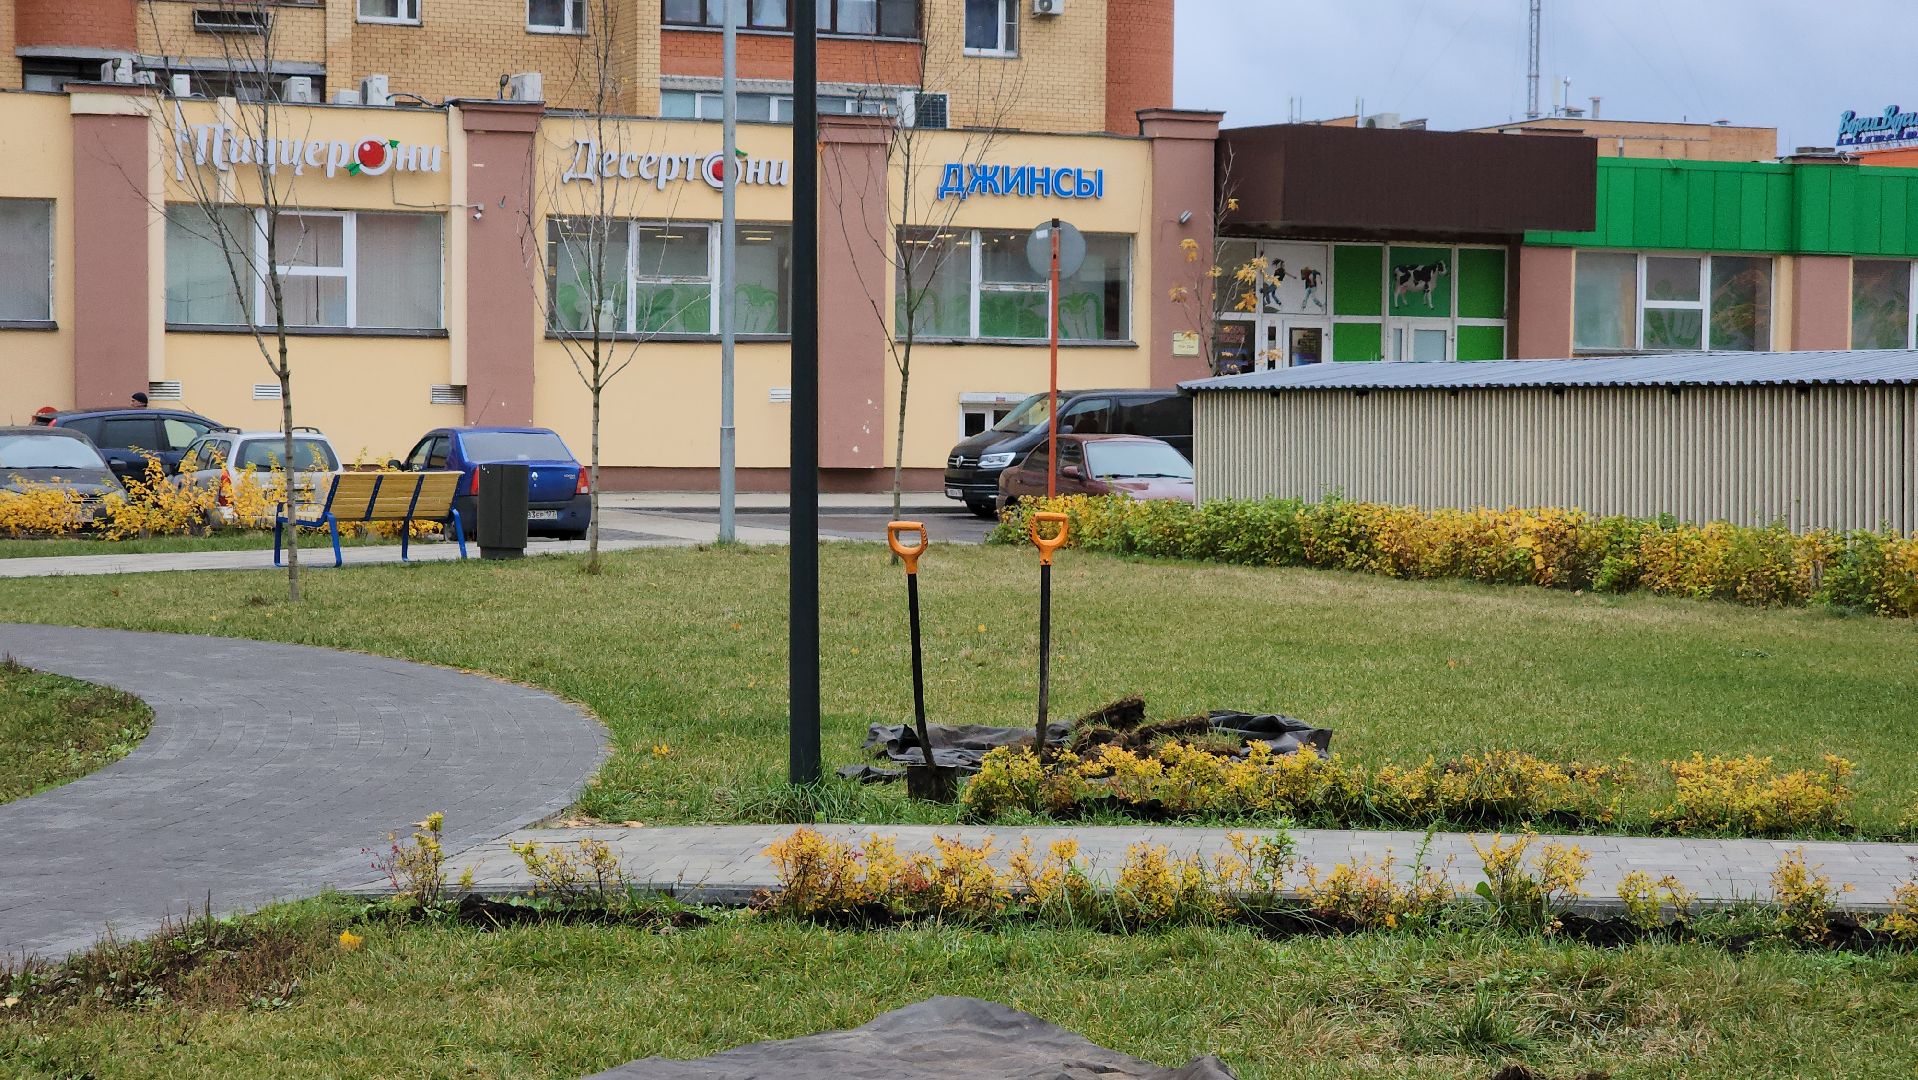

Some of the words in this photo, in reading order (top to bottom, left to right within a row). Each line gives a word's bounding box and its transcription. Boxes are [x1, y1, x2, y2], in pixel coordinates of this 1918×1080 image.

[174, 122, 441, 180] Пиццерони
[562, 139, 789, 191] Десертони
[937, 163, 1103, 201] ДЖИНСЫ
